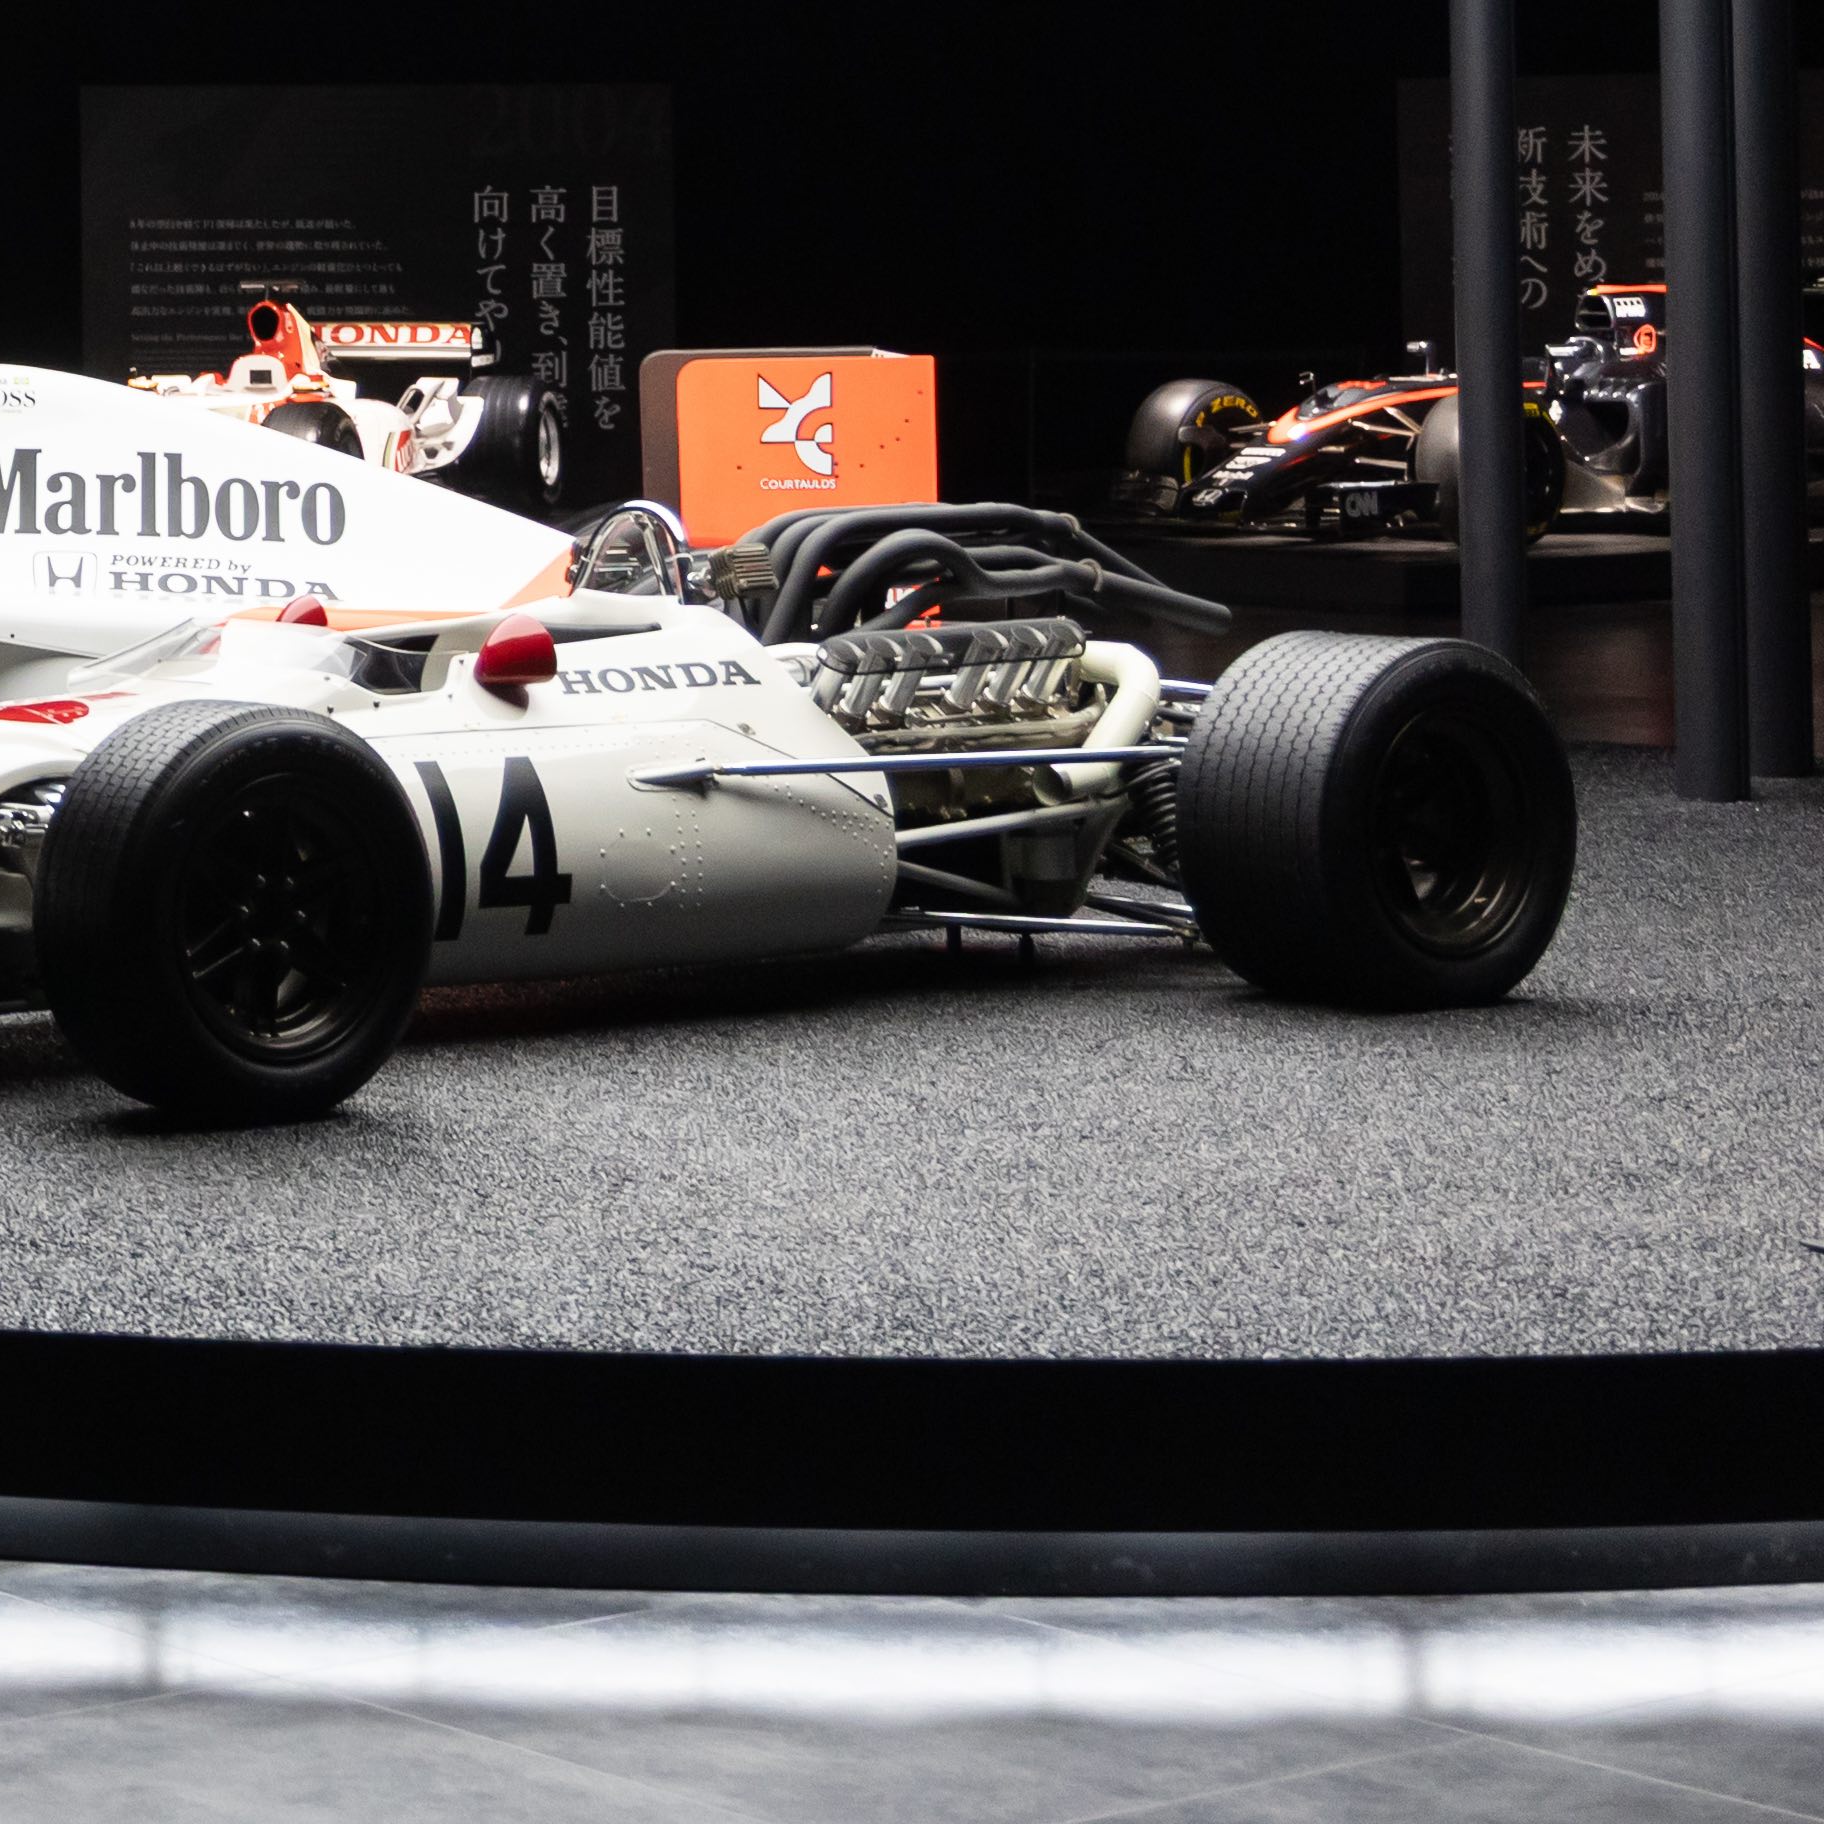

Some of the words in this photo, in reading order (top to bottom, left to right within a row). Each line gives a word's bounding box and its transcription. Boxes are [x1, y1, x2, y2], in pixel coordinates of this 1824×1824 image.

[1568, 125, 1608, 300] 未来をめ
[586, 186, 625, 430] 目標性能値を
[1210, 394, 1260, 419] ZERO
[759, 476, 837, 490] COURTAULDS
[111, 553, 222, 571] POWERED
[227, 558, 252, 575] by
[108, 571, 345, 601] HONDA
[561, 660, 761, 695] HONDA
[413, 756, 573, 942] 14
